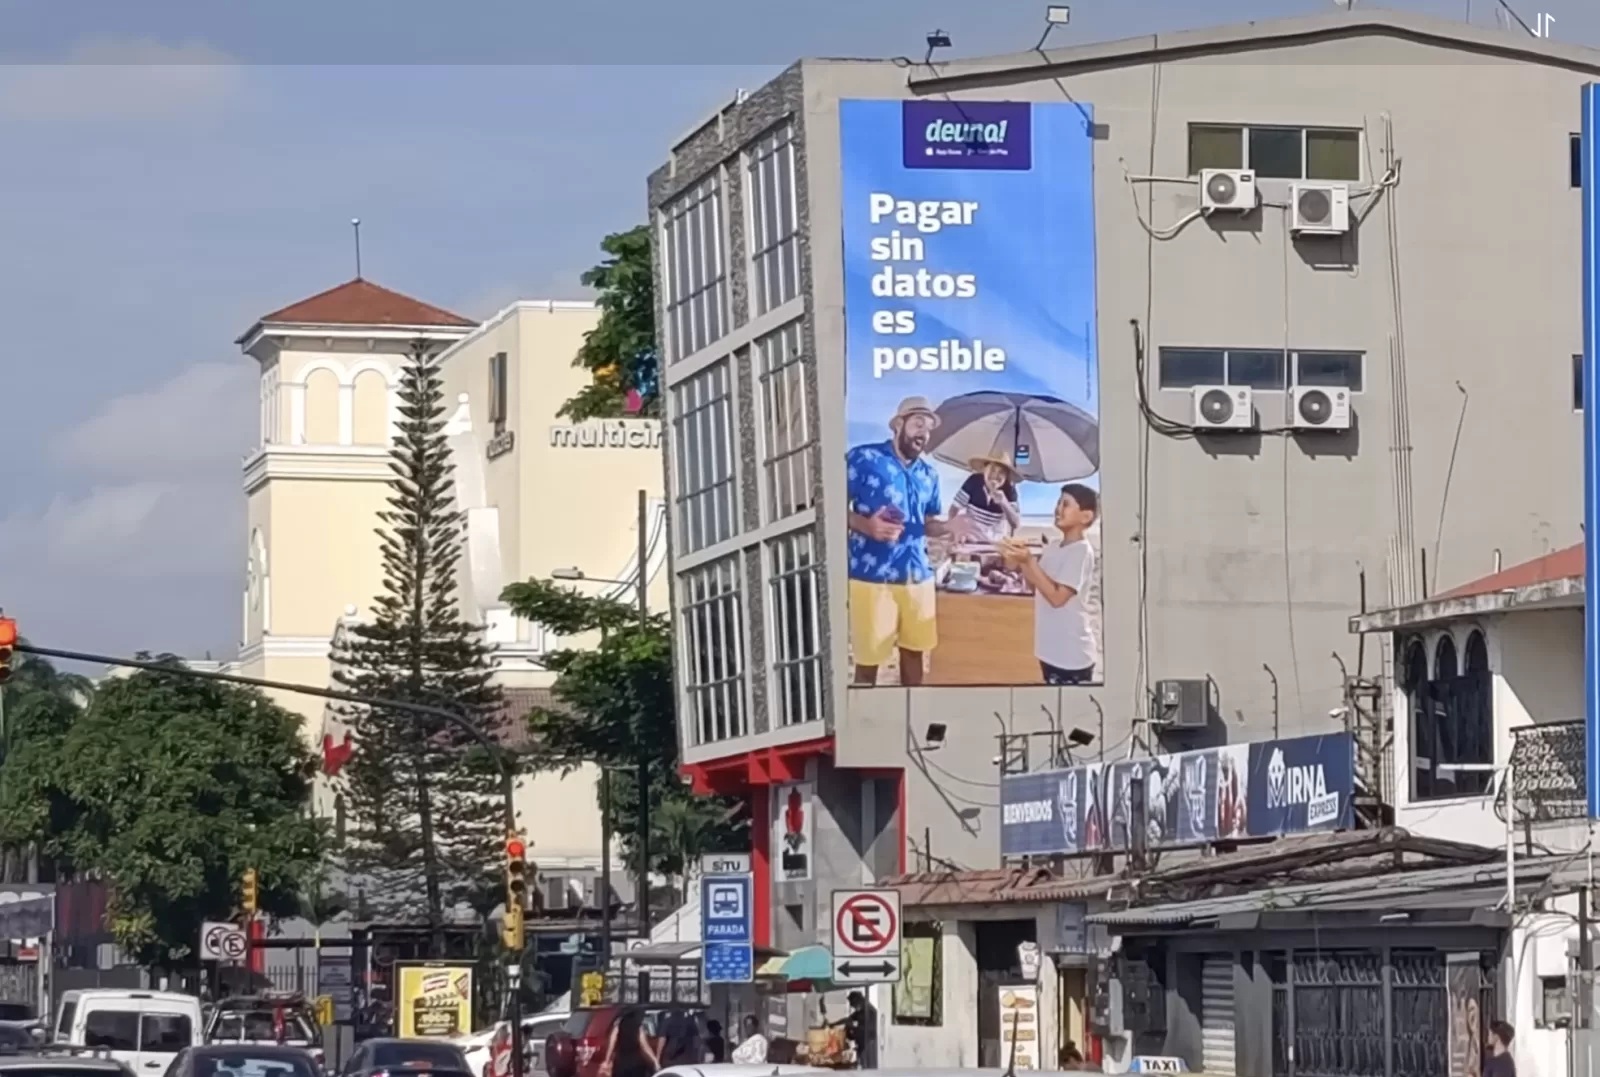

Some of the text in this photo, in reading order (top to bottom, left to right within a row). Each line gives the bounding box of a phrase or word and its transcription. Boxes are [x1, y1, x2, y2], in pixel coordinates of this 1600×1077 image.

[925, 118, 1008, 143] deuna!
[869, 193, 978, 233] Pagar
[871, 230, 924, 261] sin
[871, 266, 976, 297] datos
[872, 309, 915, 334] es
[873, 340, 1006, 378] posible
[707, 924, 745, 935] PARADA
[1142, 1059, 1177, 1071] TAXI
